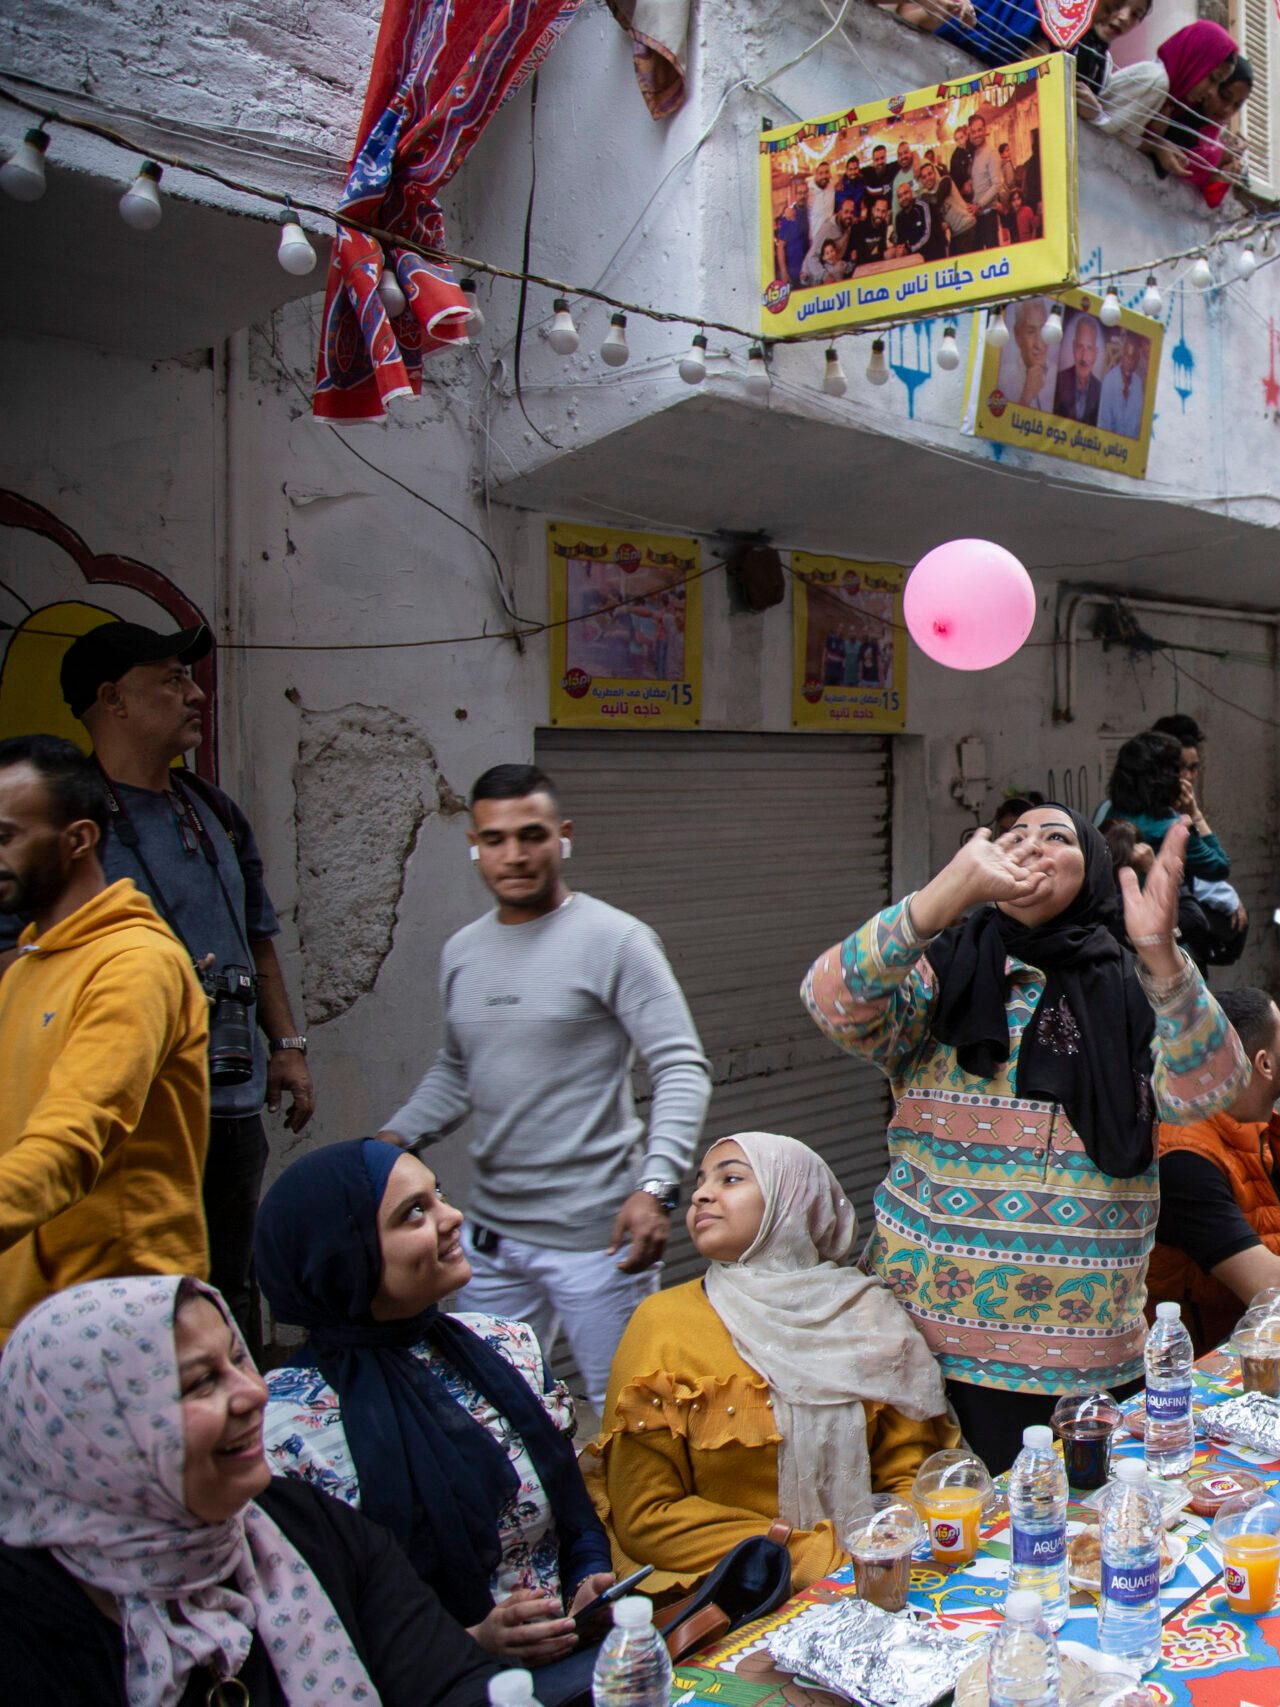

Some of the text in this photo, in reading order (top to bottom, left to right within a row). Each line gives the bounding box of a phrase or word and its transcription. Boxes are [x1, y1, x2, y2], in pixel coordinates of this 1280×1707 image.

[857, 286, 889, 307] هما
[895, 273, 929, 301] ناس
[796, 289, 851, 321] الاساس
[1010, 411, 1044, 437] قلوبنا
[671, 683, 693, 706] 15
[883, 691, 900, 711] 15
[1147, 1394, 1188, 1409] AQUAFINA
[1111, 1573, 1159, 1592] AQUAFIN
